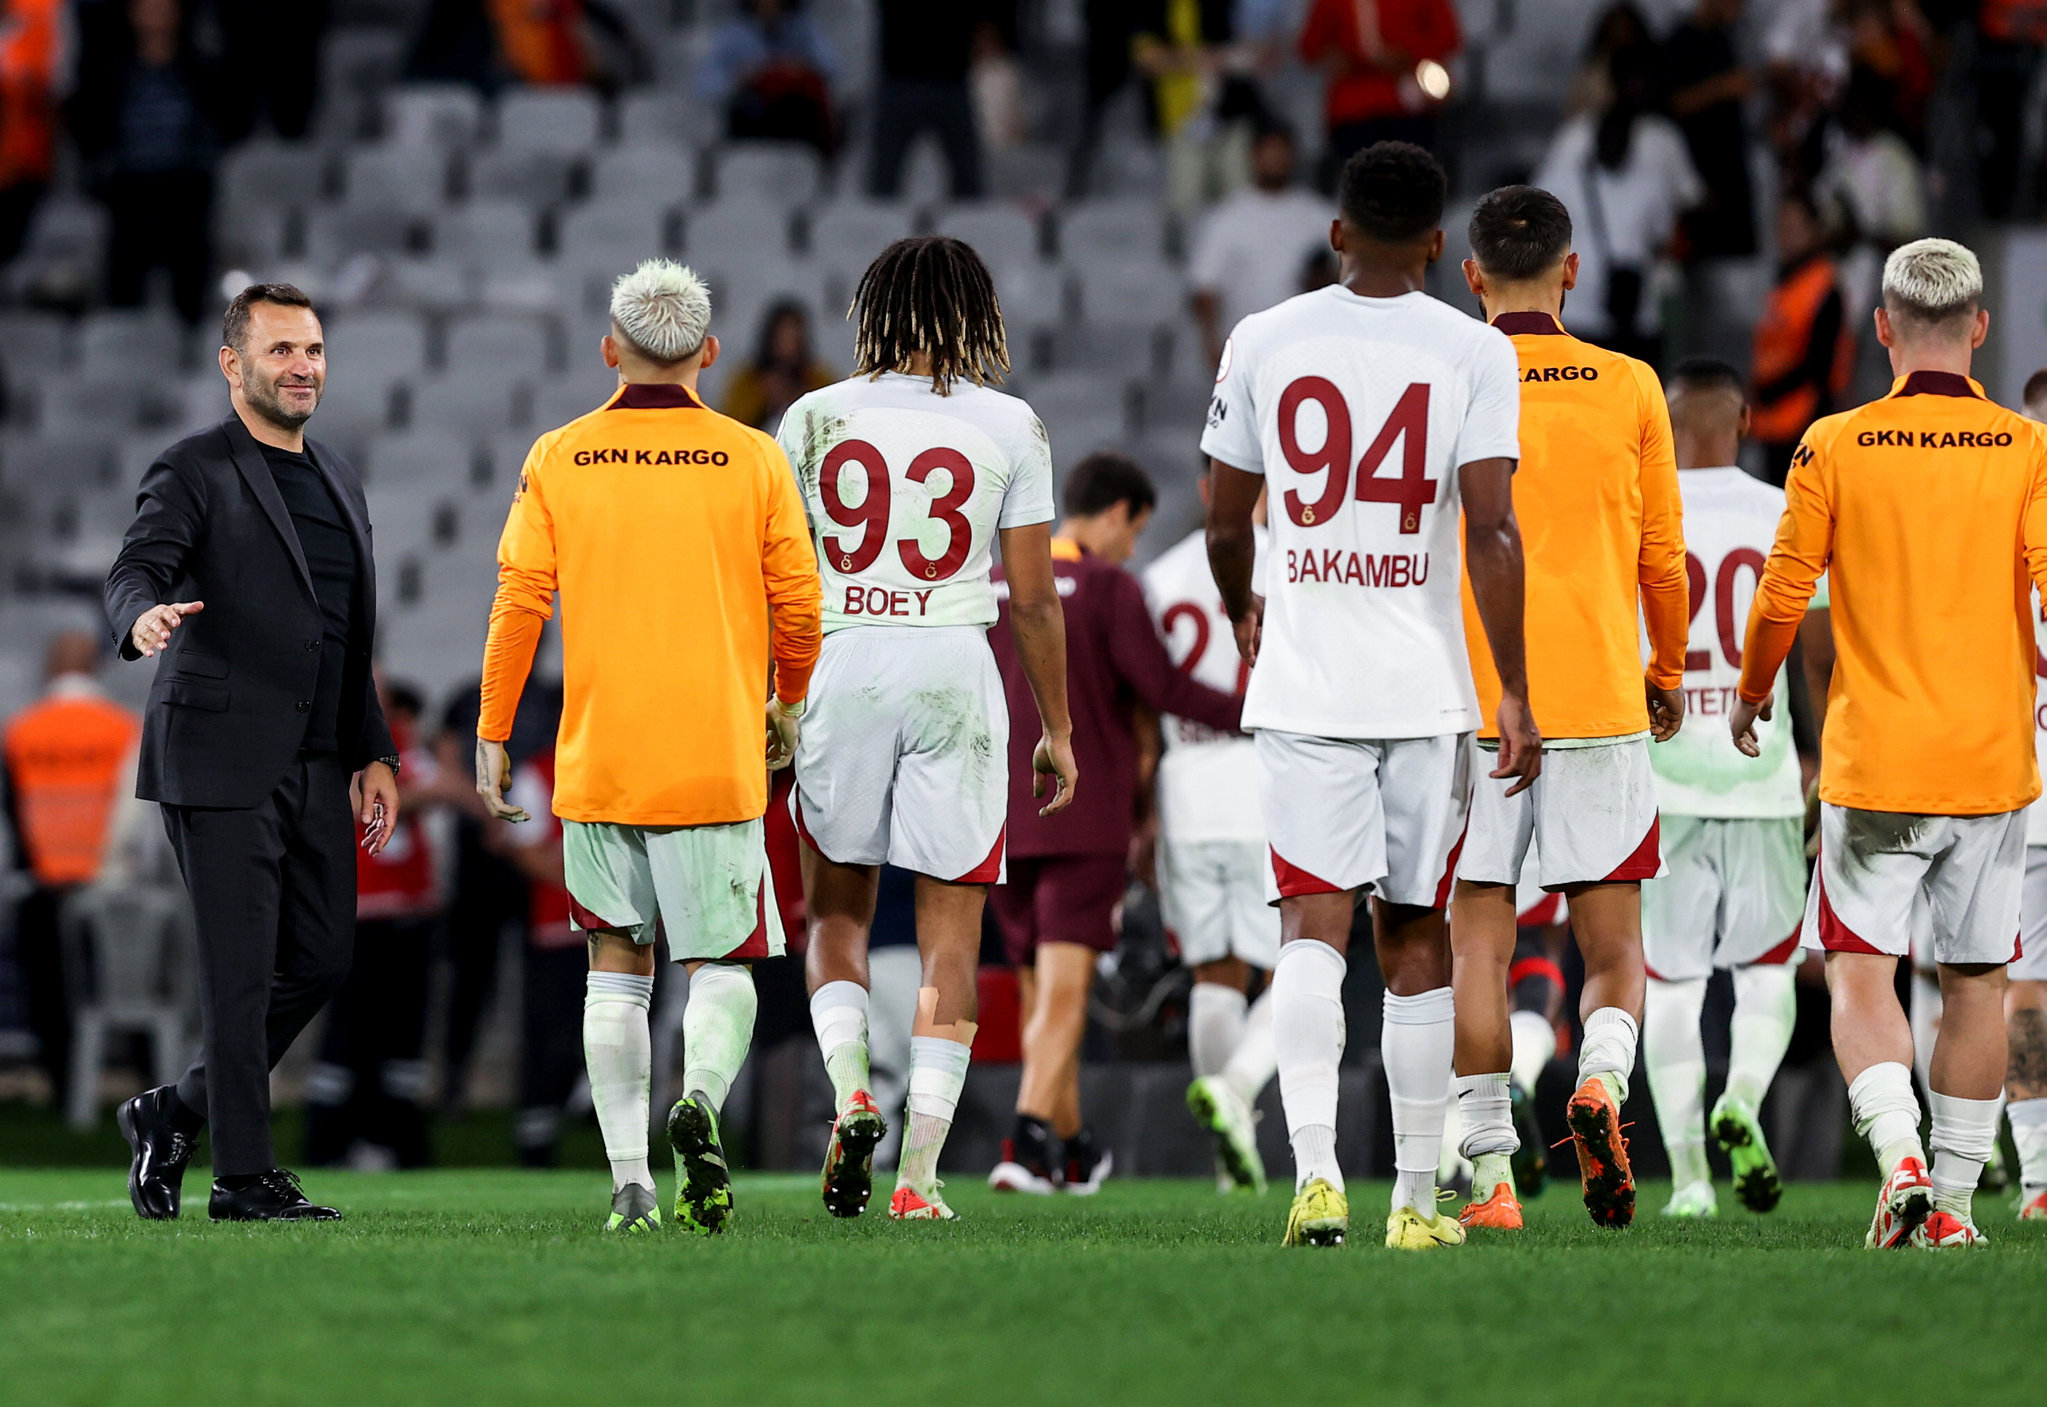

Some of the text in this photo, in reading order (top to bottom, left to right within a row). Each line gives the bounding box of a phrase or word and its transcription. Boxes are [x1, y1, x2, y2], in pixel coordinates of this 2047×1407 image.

[1518, 366, 1598, 382] ARGO
[1857, 430, 2013, 448] GKN KARGO
[574, 448, 729, 467] GKN KARGO
[1277, 375, 1437, 535] 94
[819, 439, 975, 582] 93
[1286, 548, 1429, 588] BAKAMBU
[843, 586, 933, 616] BOEY
[1684, 686, 1738, 715] TET
